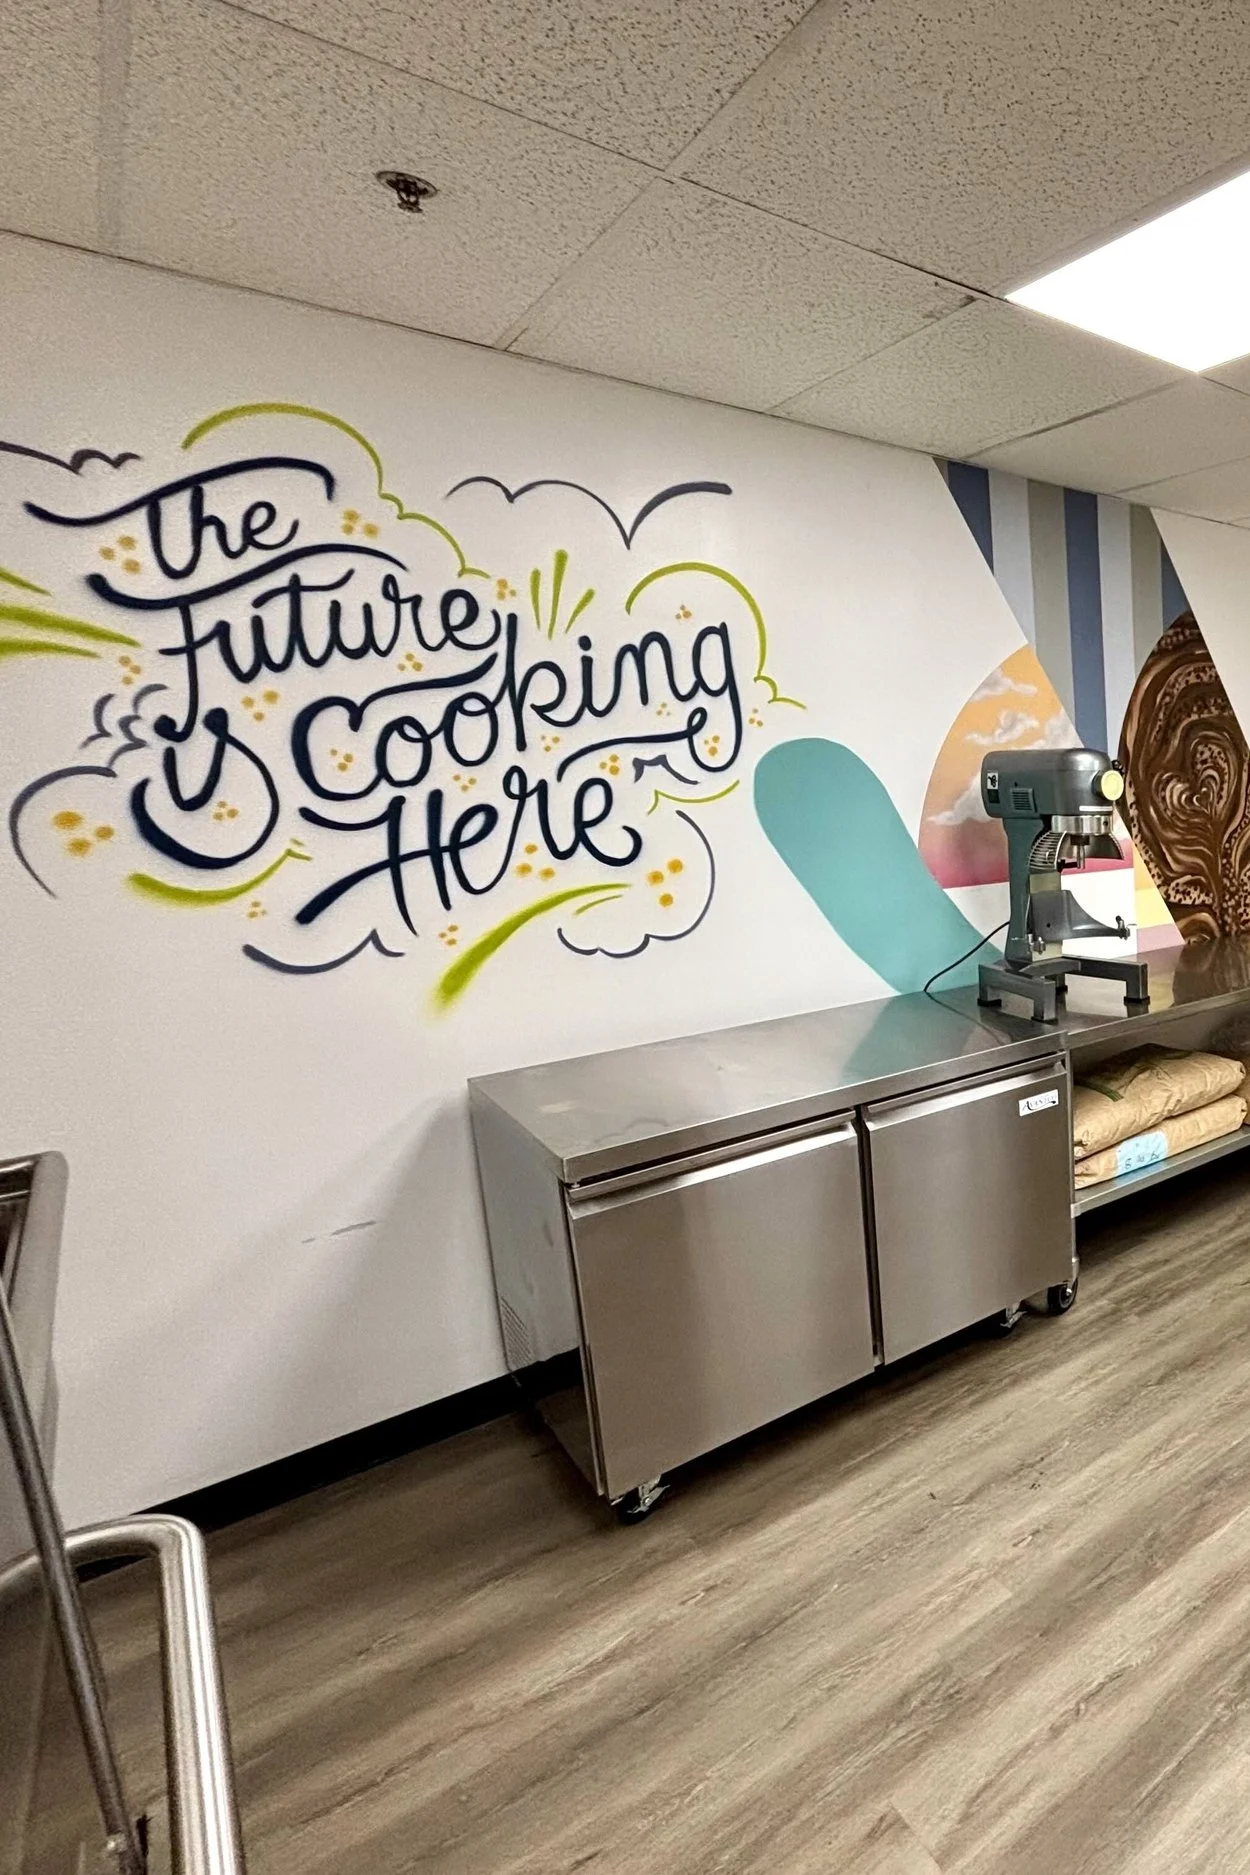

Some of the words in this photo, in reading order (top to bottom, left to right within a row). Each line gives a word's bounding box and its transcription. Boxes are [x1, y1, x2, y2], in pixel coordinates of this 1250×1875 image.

[85, 543, 502, 742] Future
[290, 612, 745, 802] Cooking
[294, 764, 644, 936] Here
